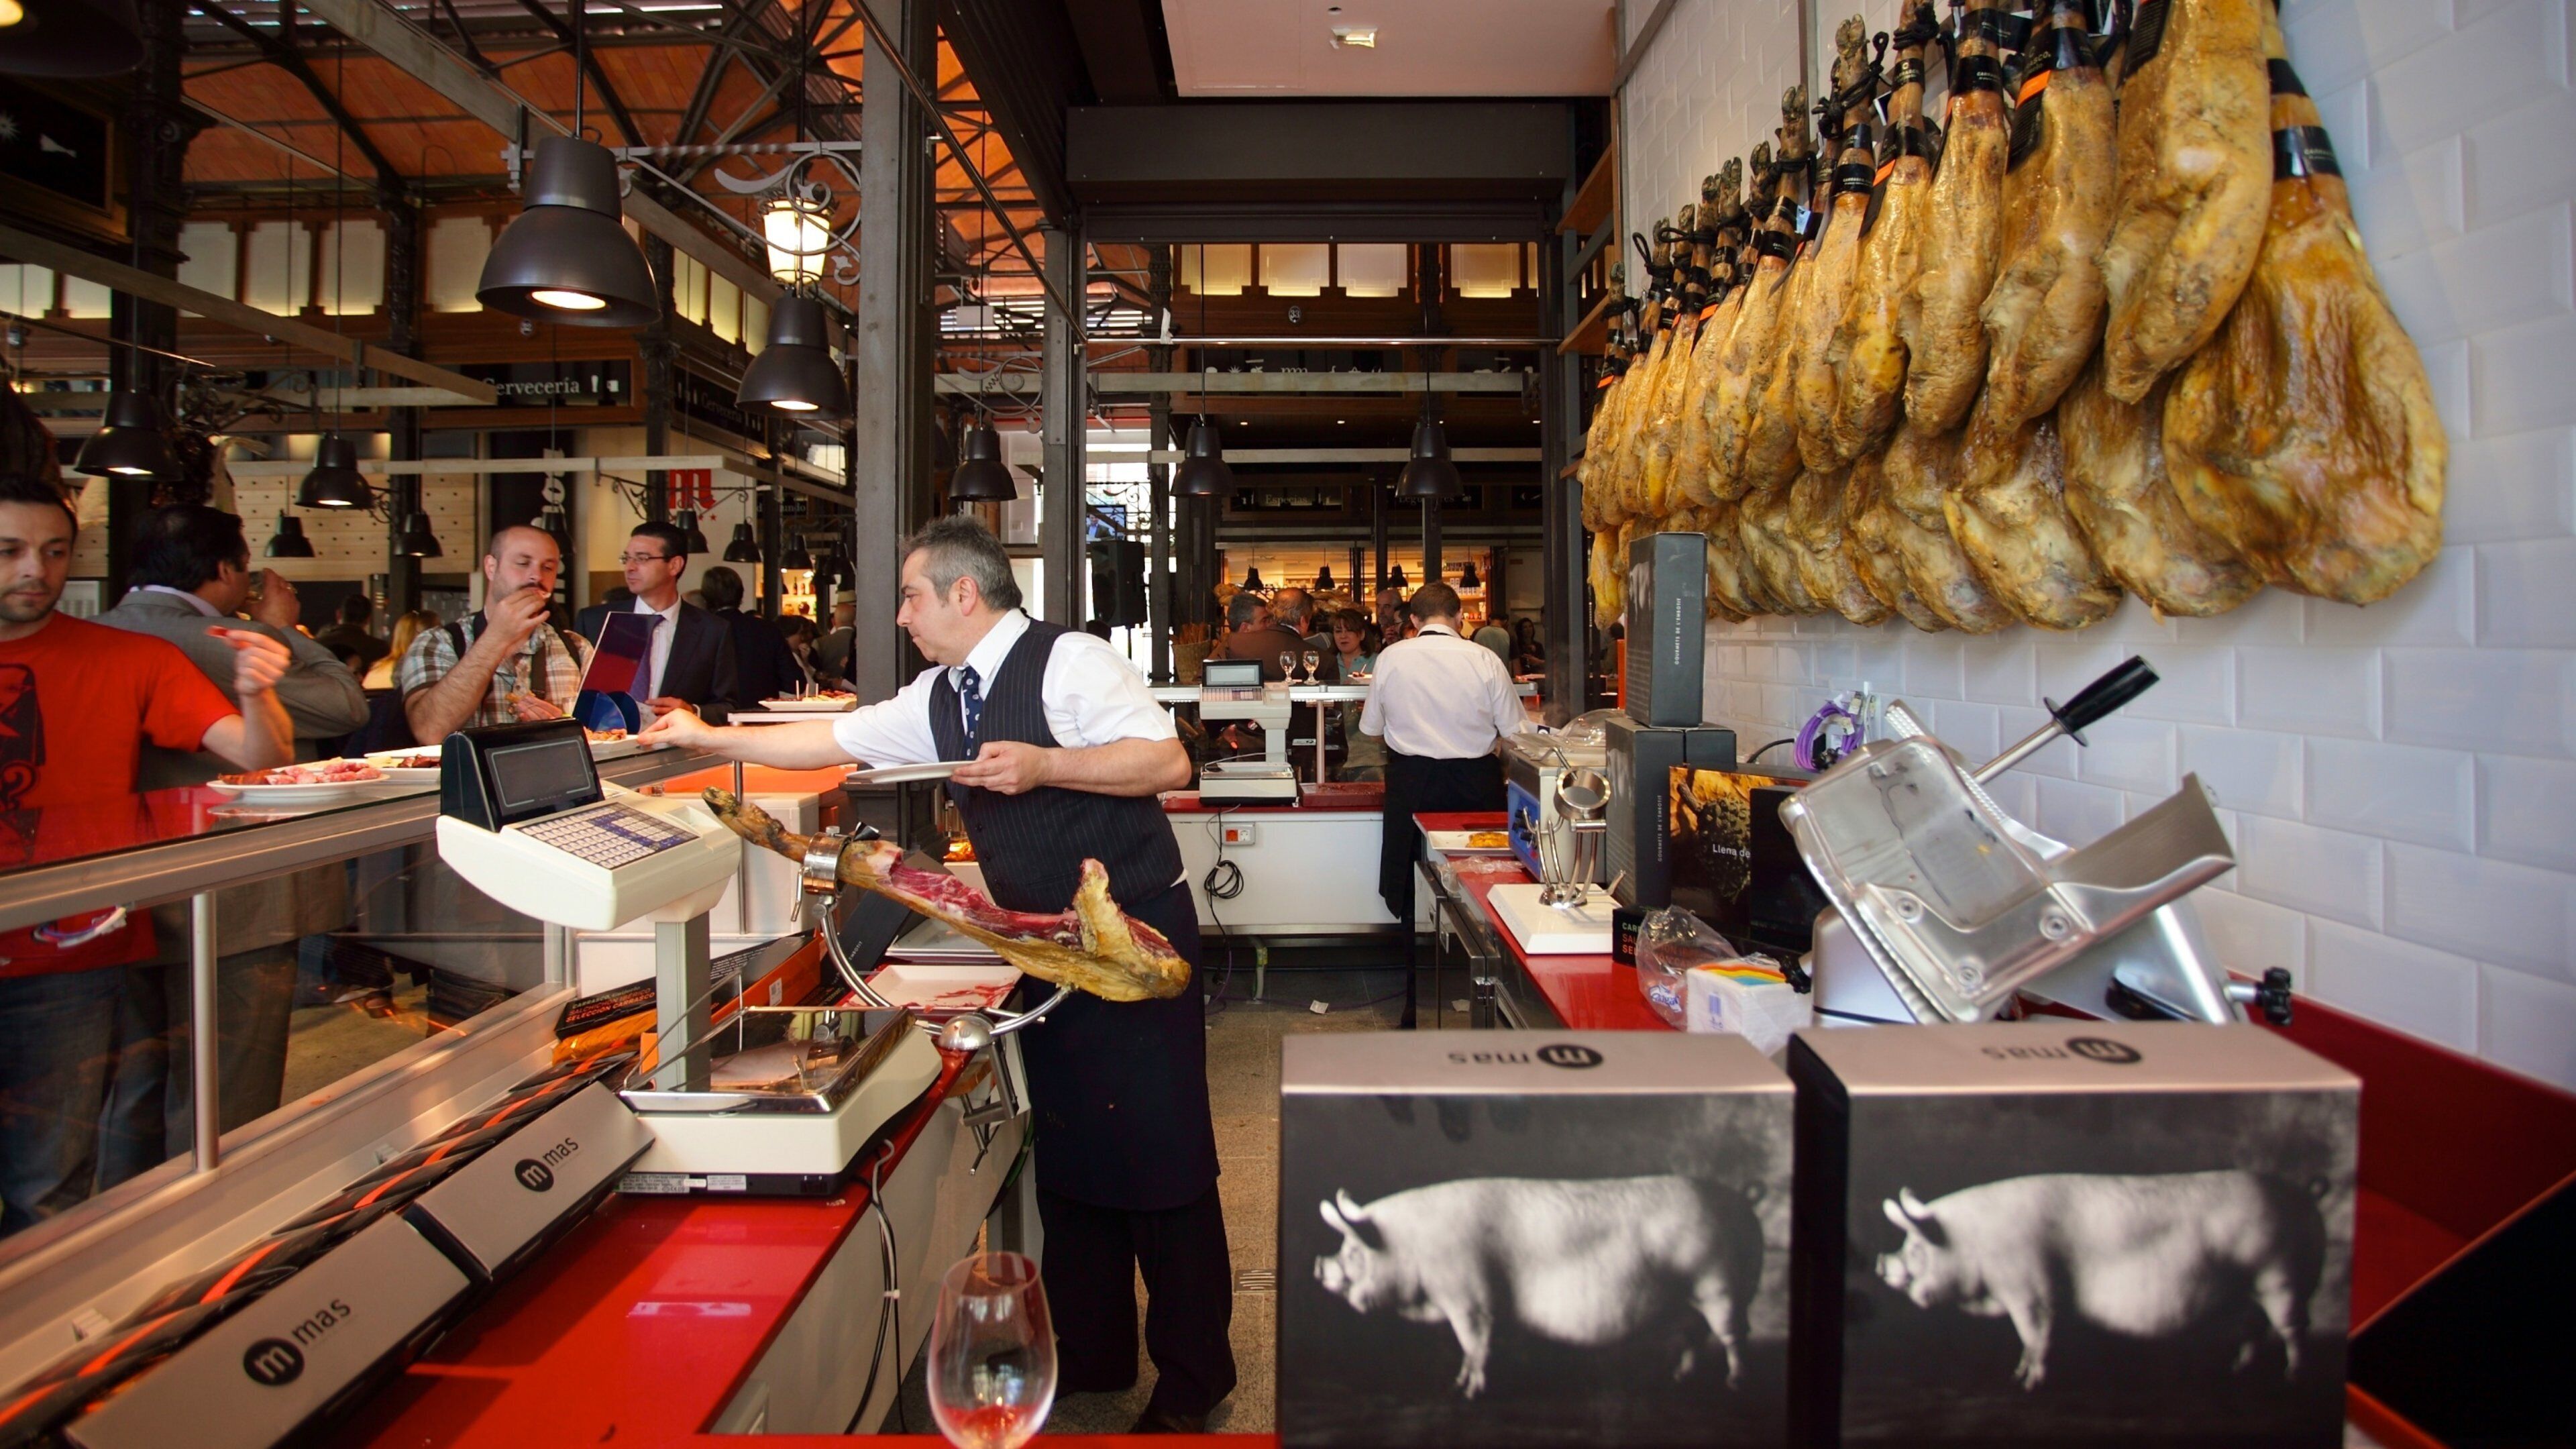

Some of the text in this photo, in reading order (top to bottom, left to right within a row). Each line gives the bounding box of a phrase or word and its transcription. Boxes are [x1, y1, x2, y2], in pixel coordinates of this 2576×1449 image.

[1265, 494, 1308, 506] Especias
[1399, 495, 1455, 505] Legues
[1713, 843, 1737, 856] Llena
[848, 941, 863, 961] EMBOTIT
[612, 992, 655, 1010] CARRASCO
[1448, 1052, 1530, 1064] mas
[1981, 1047, 2068, 1059] mas
[543, 1137, 578, 1166] mas
[292, 1299, 351, 1346] mas
